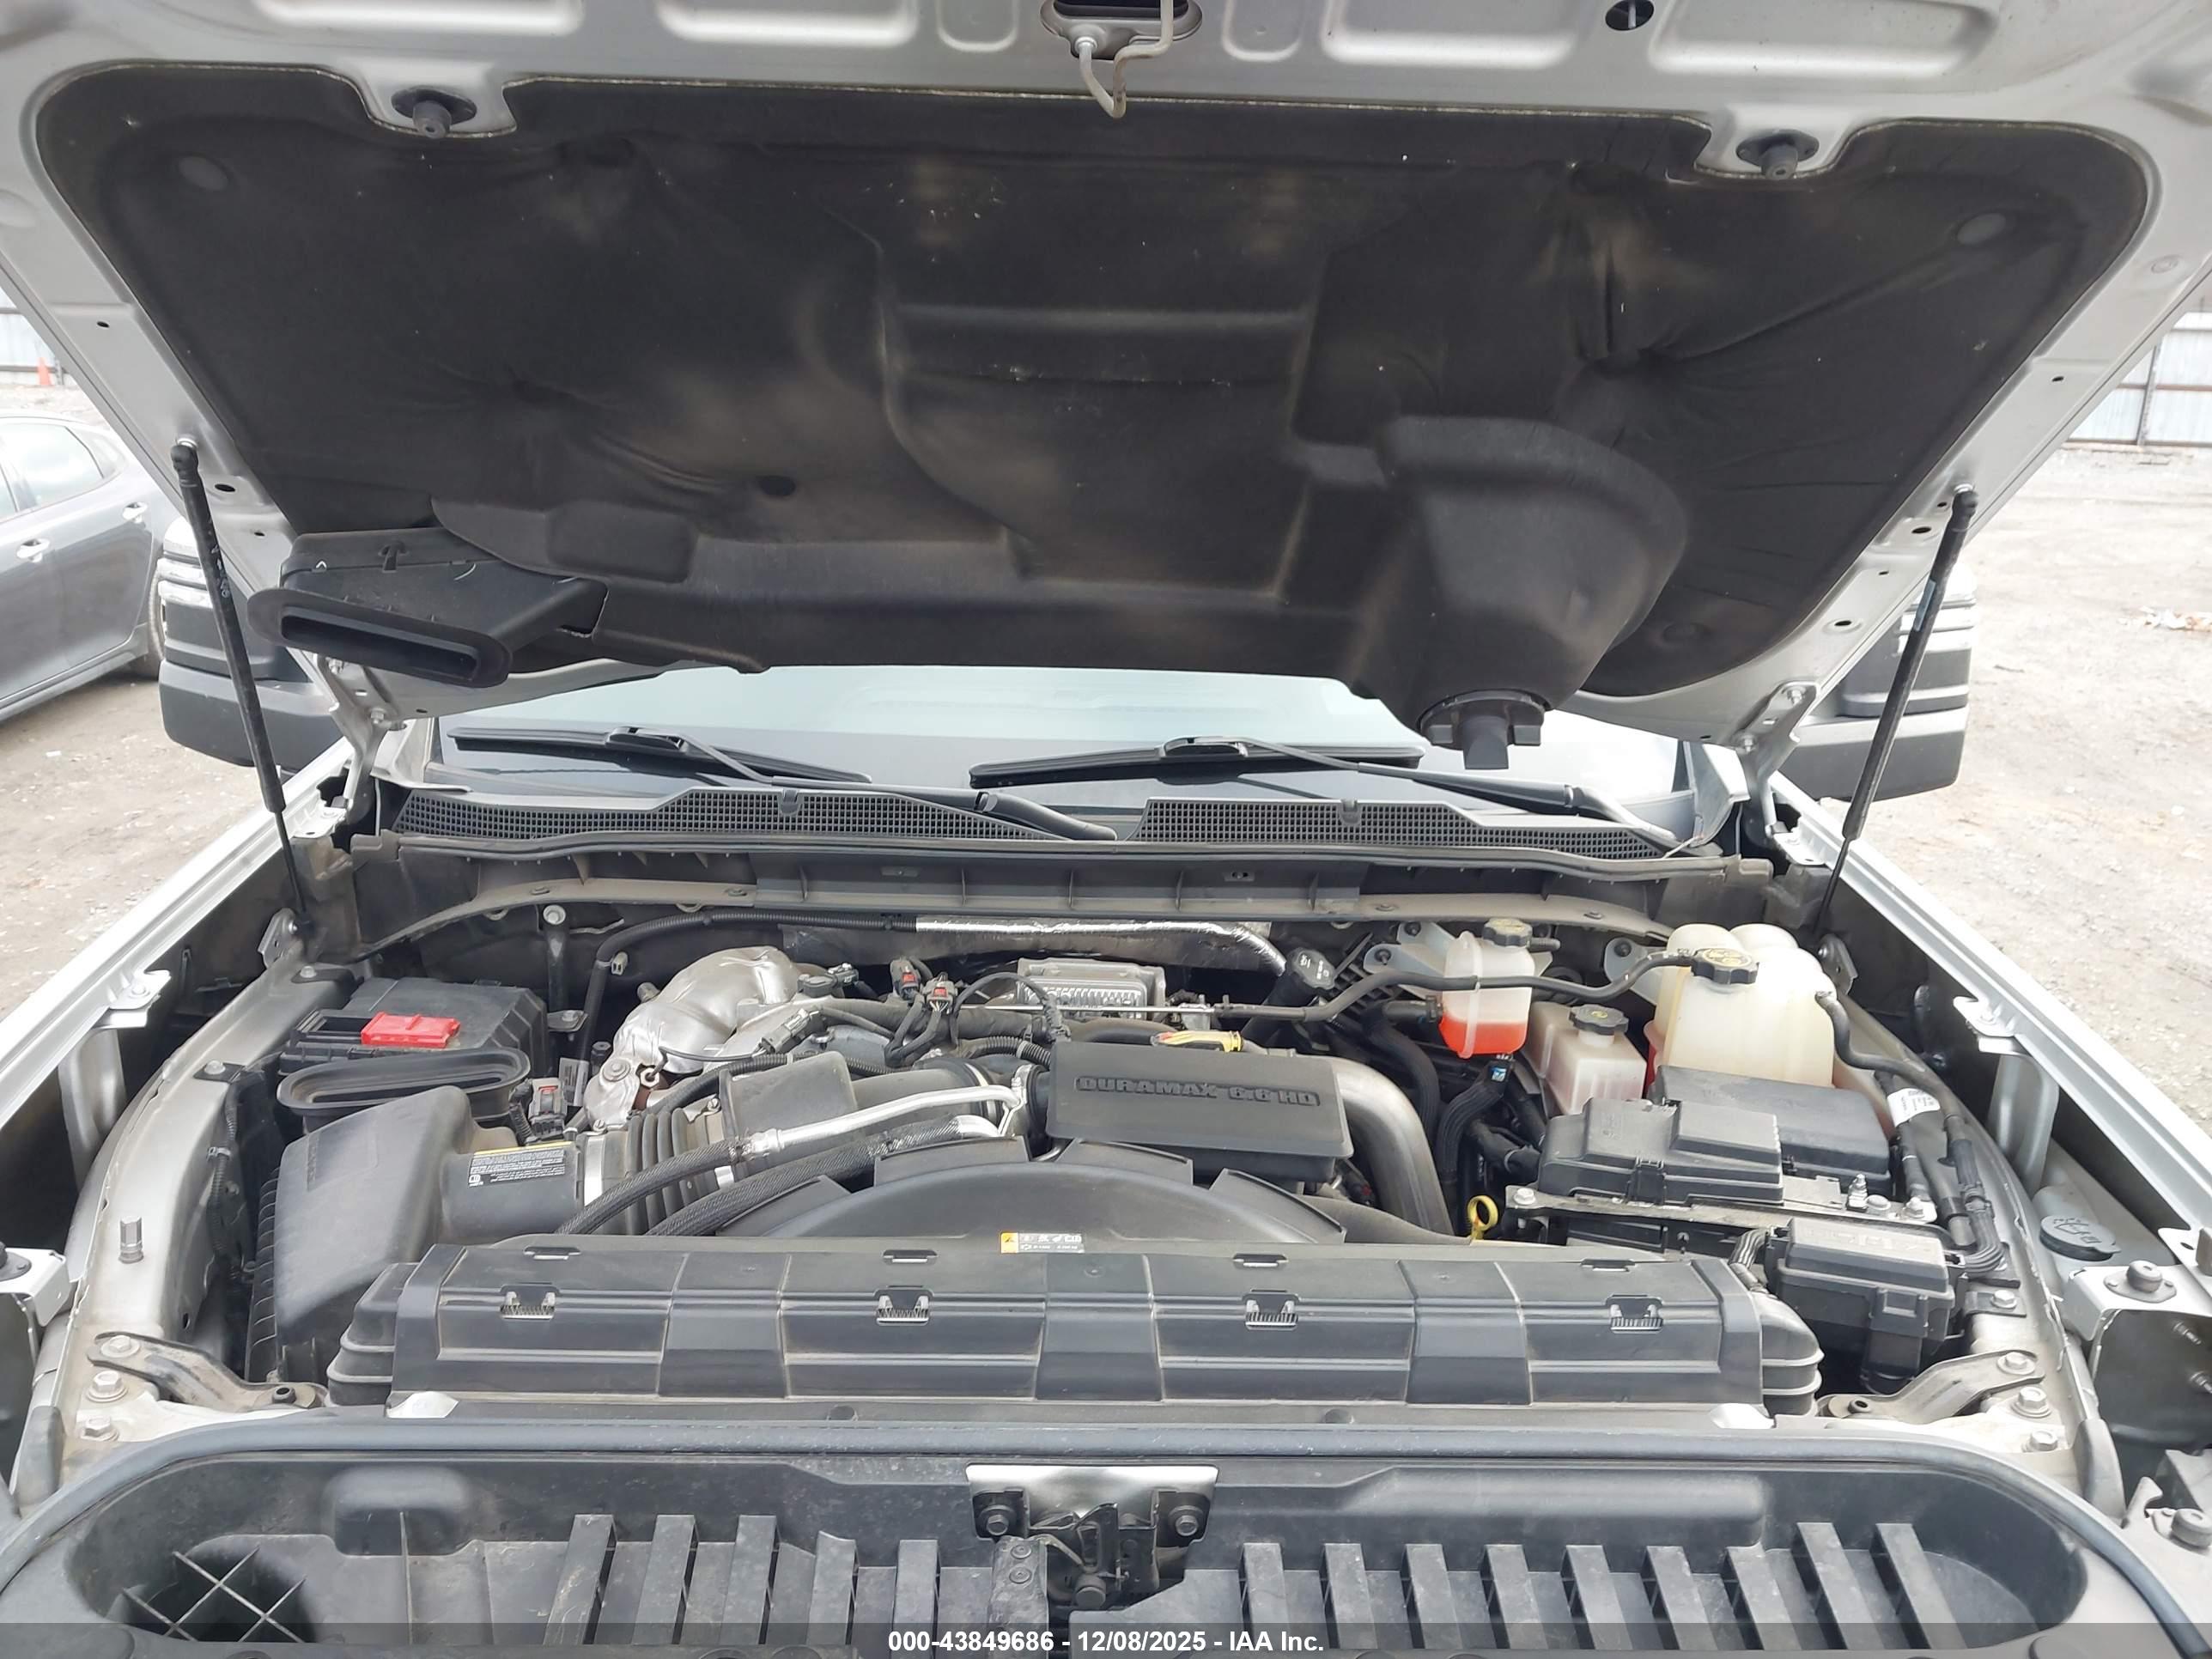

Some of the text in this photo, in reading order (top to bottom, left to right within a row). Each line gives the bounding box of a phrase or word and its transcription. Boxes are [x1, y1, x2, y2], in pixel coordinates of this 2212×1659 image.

[1079, 1077, 1317, 1106] DURAMAX 6.6 HD
